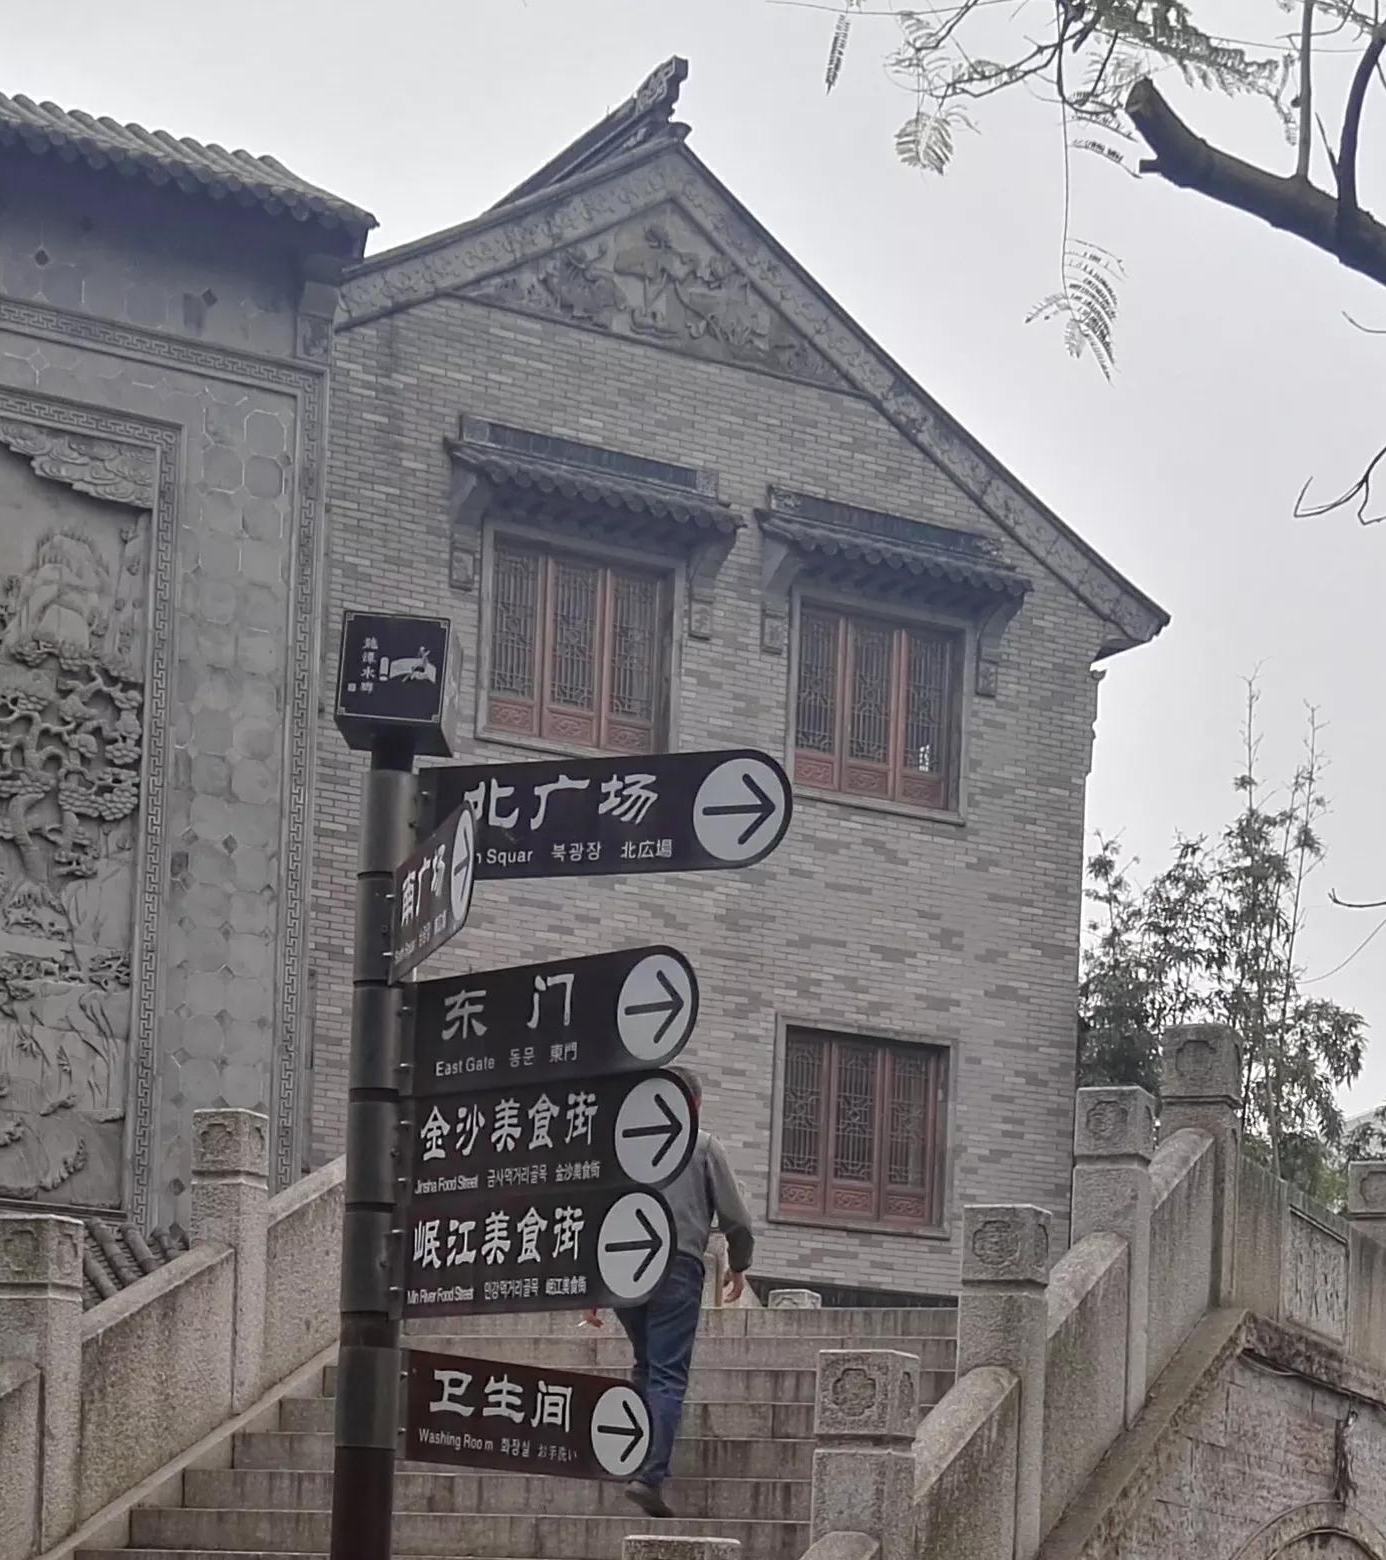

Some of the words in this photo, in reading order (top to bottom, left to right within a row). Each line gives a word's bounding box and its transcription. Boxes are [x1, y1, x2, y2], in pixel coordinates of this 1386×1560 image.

[464, 774, 658, 830] 北广场
[486, 849, 534, 867] Squar
[549, 1041, 578, 1063] 東門
[435, 1060, 463, 1077] East
[466, 1055, 495, 1073] Gate
[420, 1091, 599, 1161] 金沙美食街
[438, 1176, 456, 1191] Food
[413, 1206, 585, 1269] 岷江美食街
[429, 1369, 572, 1433] 卫生间
[419, 1428, 461, 1450] Washing
[501, 1438, 530, 1457] 화장실
